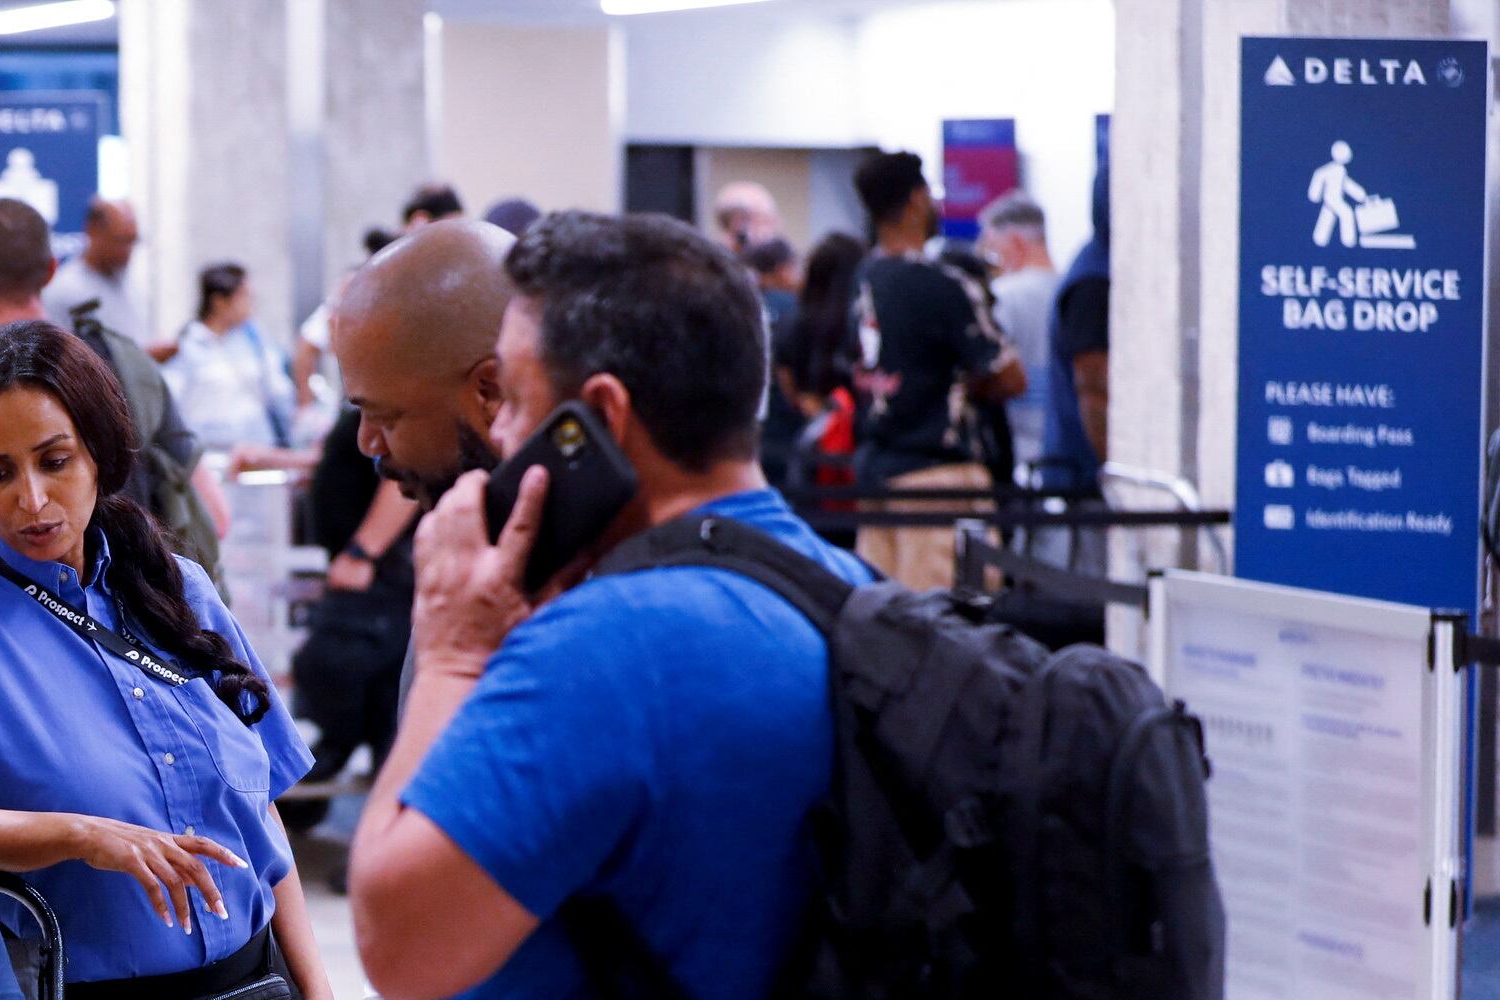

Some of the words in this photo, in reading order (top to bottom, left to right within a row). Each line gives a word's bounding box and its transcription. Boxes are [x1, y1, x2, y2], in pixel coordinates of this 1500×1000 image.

[1304, 57, 1428, 86] DELTA
[1261, 264, 1461, 300] SELF-SERVICE
[1283, 298, 1348, 331] BAG
[1353, 301, 1439, 332] DROP
[1265, 380, 1333, 406] PLEASE
[1307, 421, 1376, 448] Boarding
[1377, 424, 1414, 446] Pass
[1306, 464, 1345, 490] Bags
[1347, 465, 1402, 491] Tagged
[1306, 508, 1403, 532] Identification
[1406, 510, 1453, 536] Ready
[37, 591, 85, 626] Prospect
